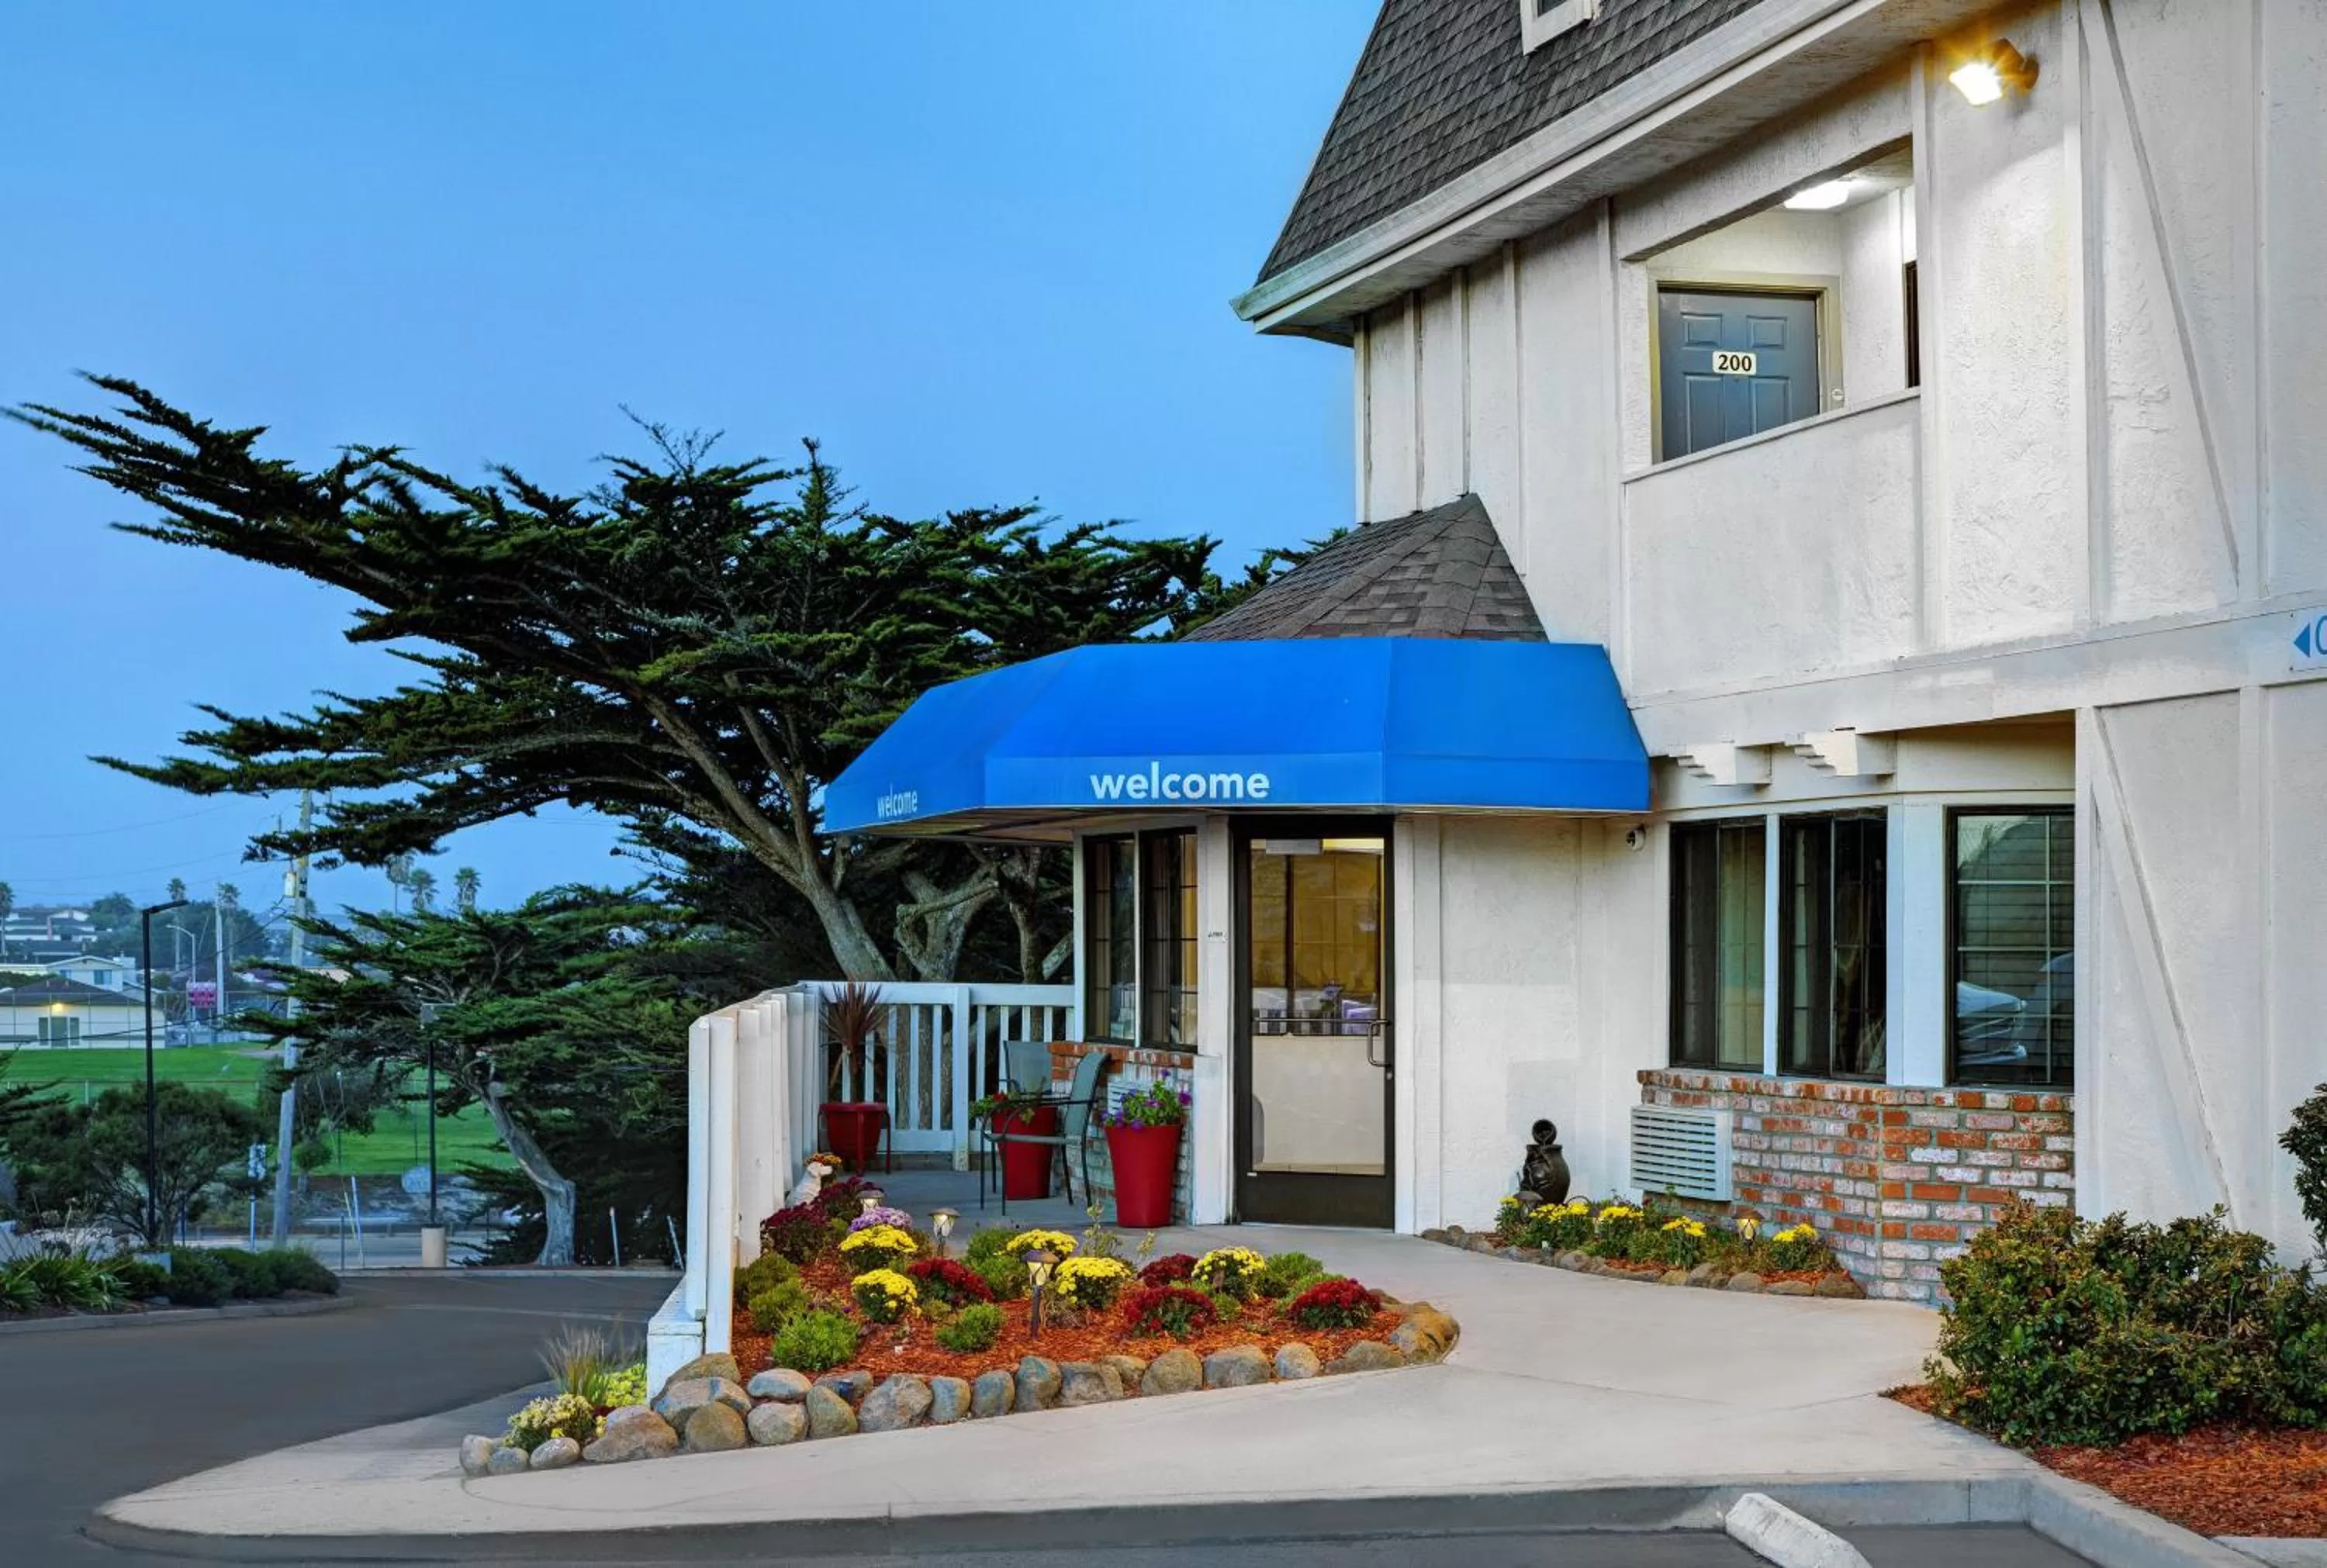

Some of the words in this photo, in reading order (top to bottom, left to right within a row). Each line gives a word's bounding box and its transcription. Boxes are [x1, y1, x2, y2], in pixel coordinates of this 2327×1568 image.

[1718, 354, 1752, 371] 200
[1089, 761, 1271, 800] welcome
[877, 782, 918, 819] welcome
